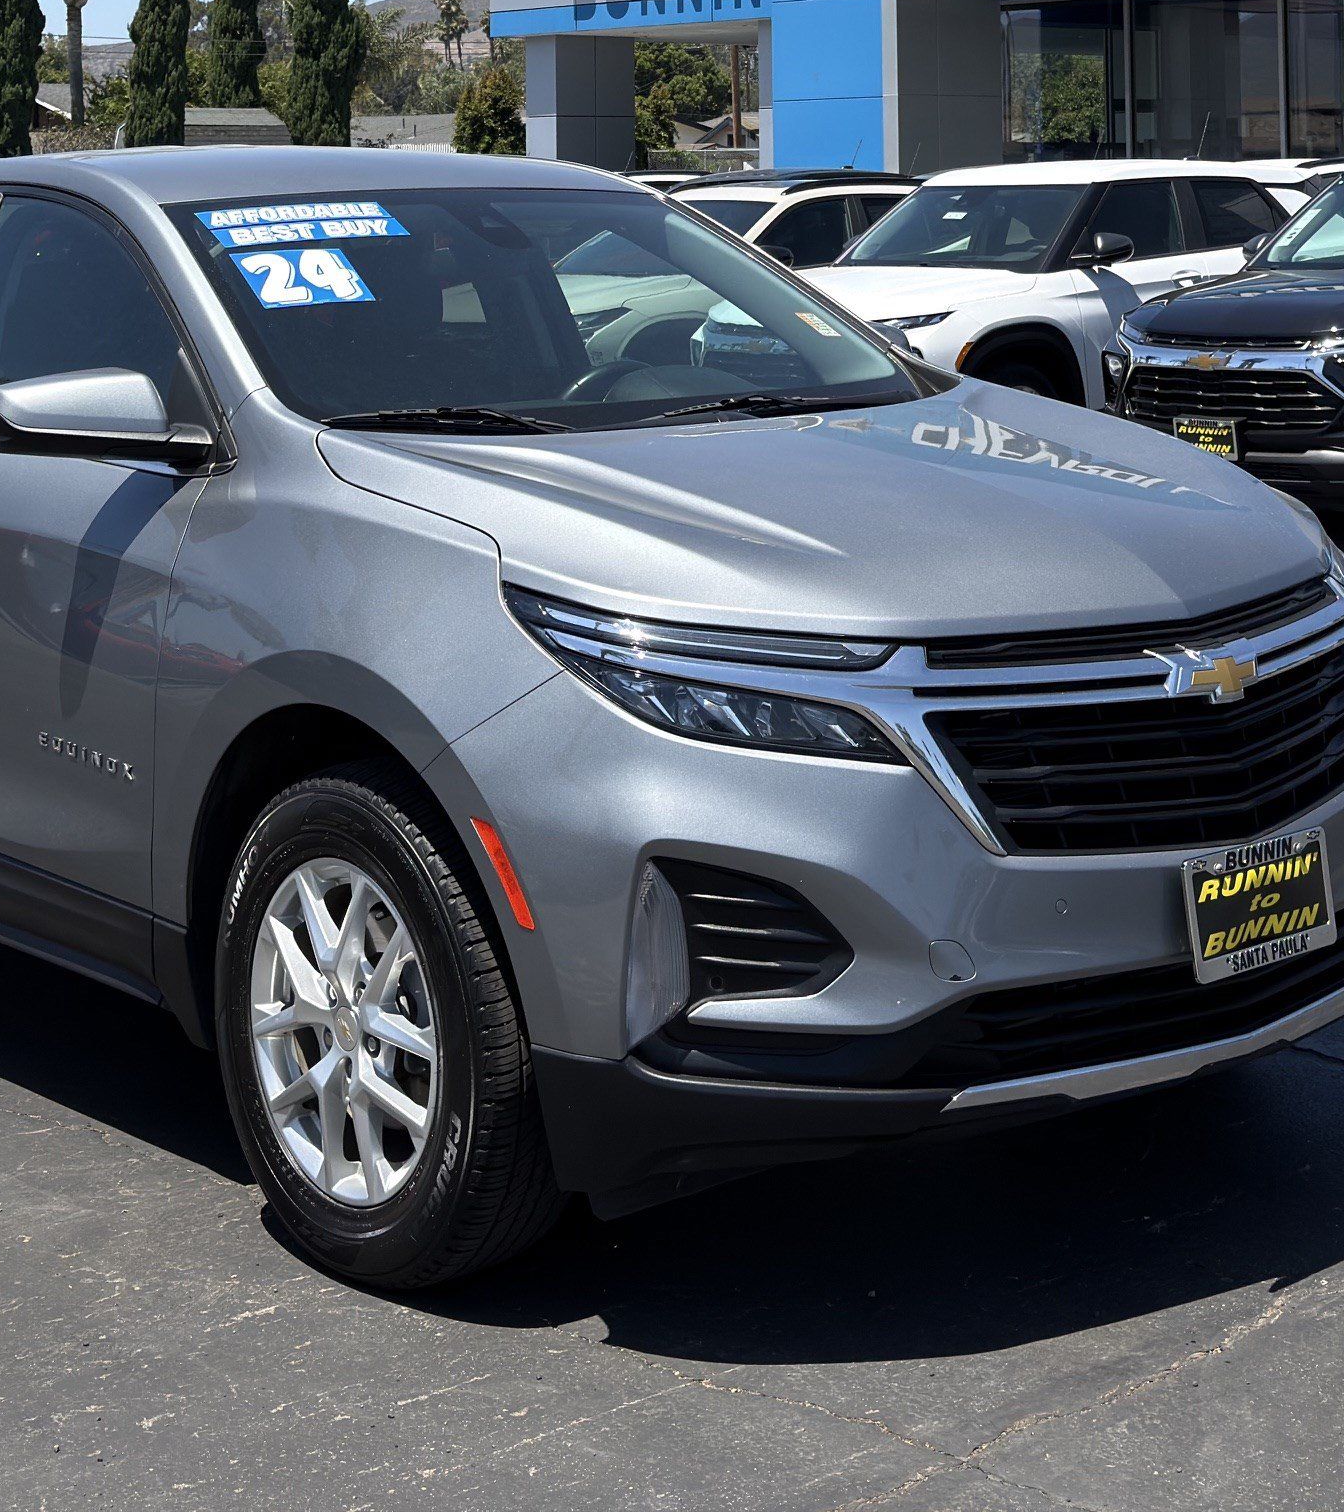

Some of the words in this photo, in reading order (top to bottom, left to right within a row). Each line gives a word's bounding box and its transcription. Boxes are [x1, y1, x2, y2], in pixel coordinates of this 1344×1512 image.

[209, 201, 382, 228] AFFORDABLE
[228, 222, 316, 246] BEST
[320, 218, 389, 237] BUY
[240, 248, 364, 304] 24
[1199, 435, 1213, 443] to
[38, 731, 135, 781] EQUINOX
[1224, 837, 1293, 871] BUNNIN
[1197, 851, 1319, 904] RUNNIN'
[1249, 892, 1281, 912] to
[1203, 903, 1320, 958] BUNNIN
